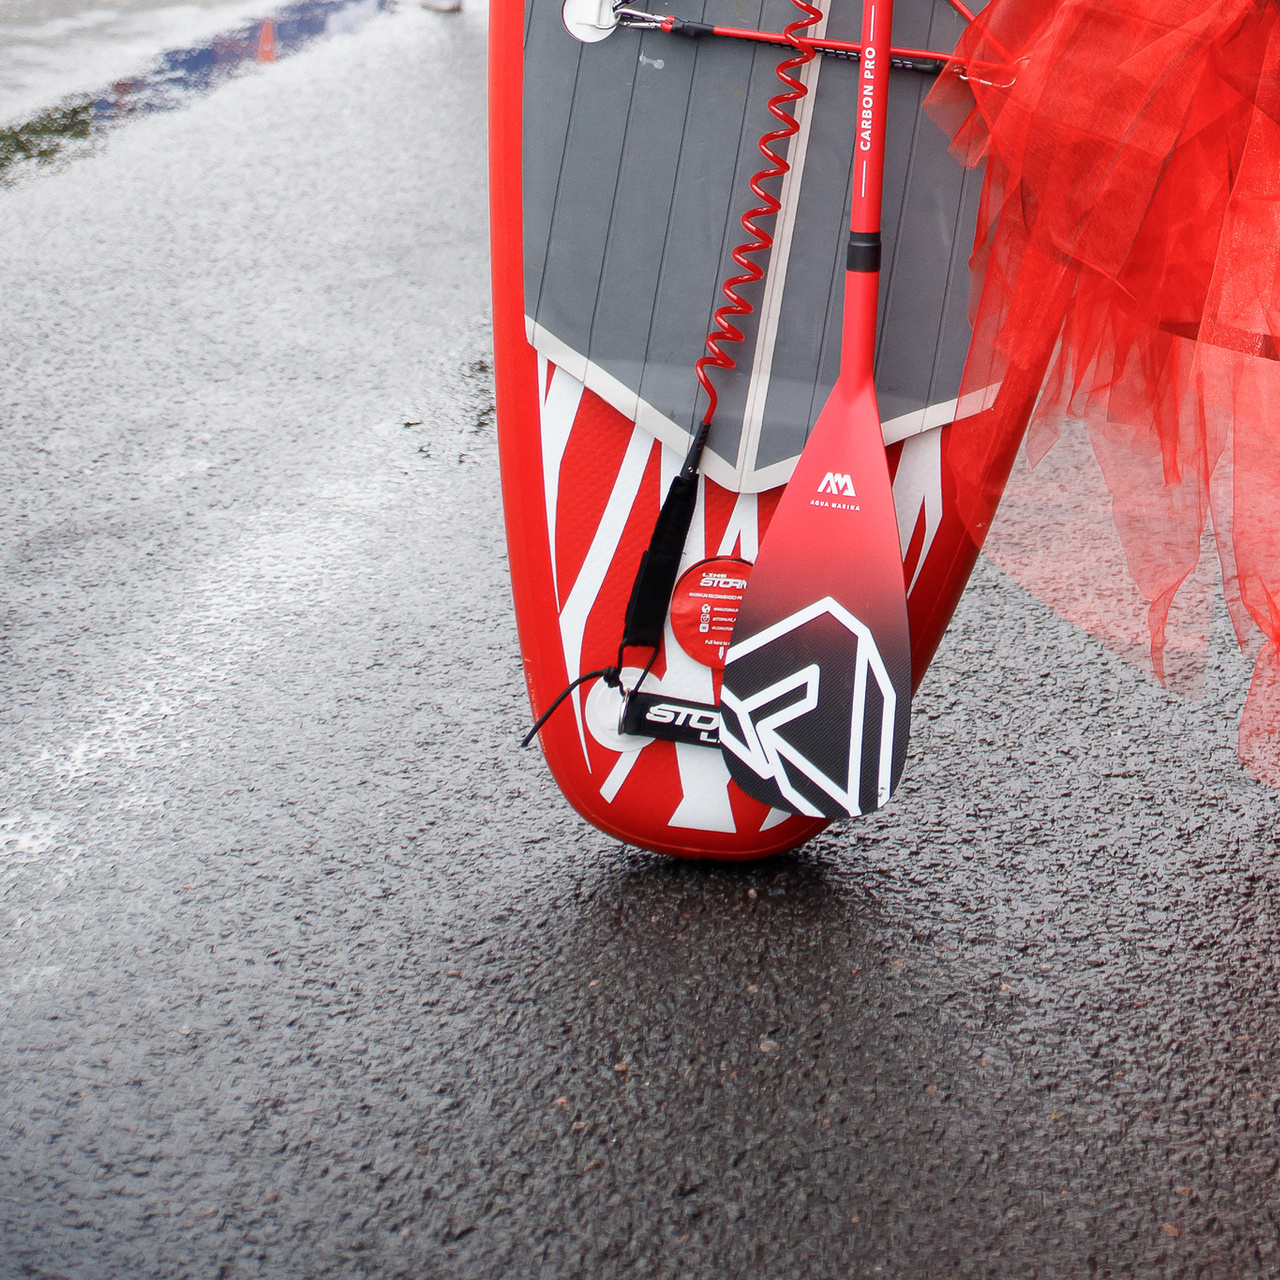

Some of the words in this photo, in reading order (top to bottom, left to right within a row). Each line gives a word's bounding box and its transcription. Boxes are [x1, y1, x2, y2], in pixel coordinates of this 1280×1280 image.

[864, 46, 876, 79] PRO
[860, 84, 874, 151] CARBON
[831, 502, 860, 511] MARINA
[646, 703, 720, 731] STO
